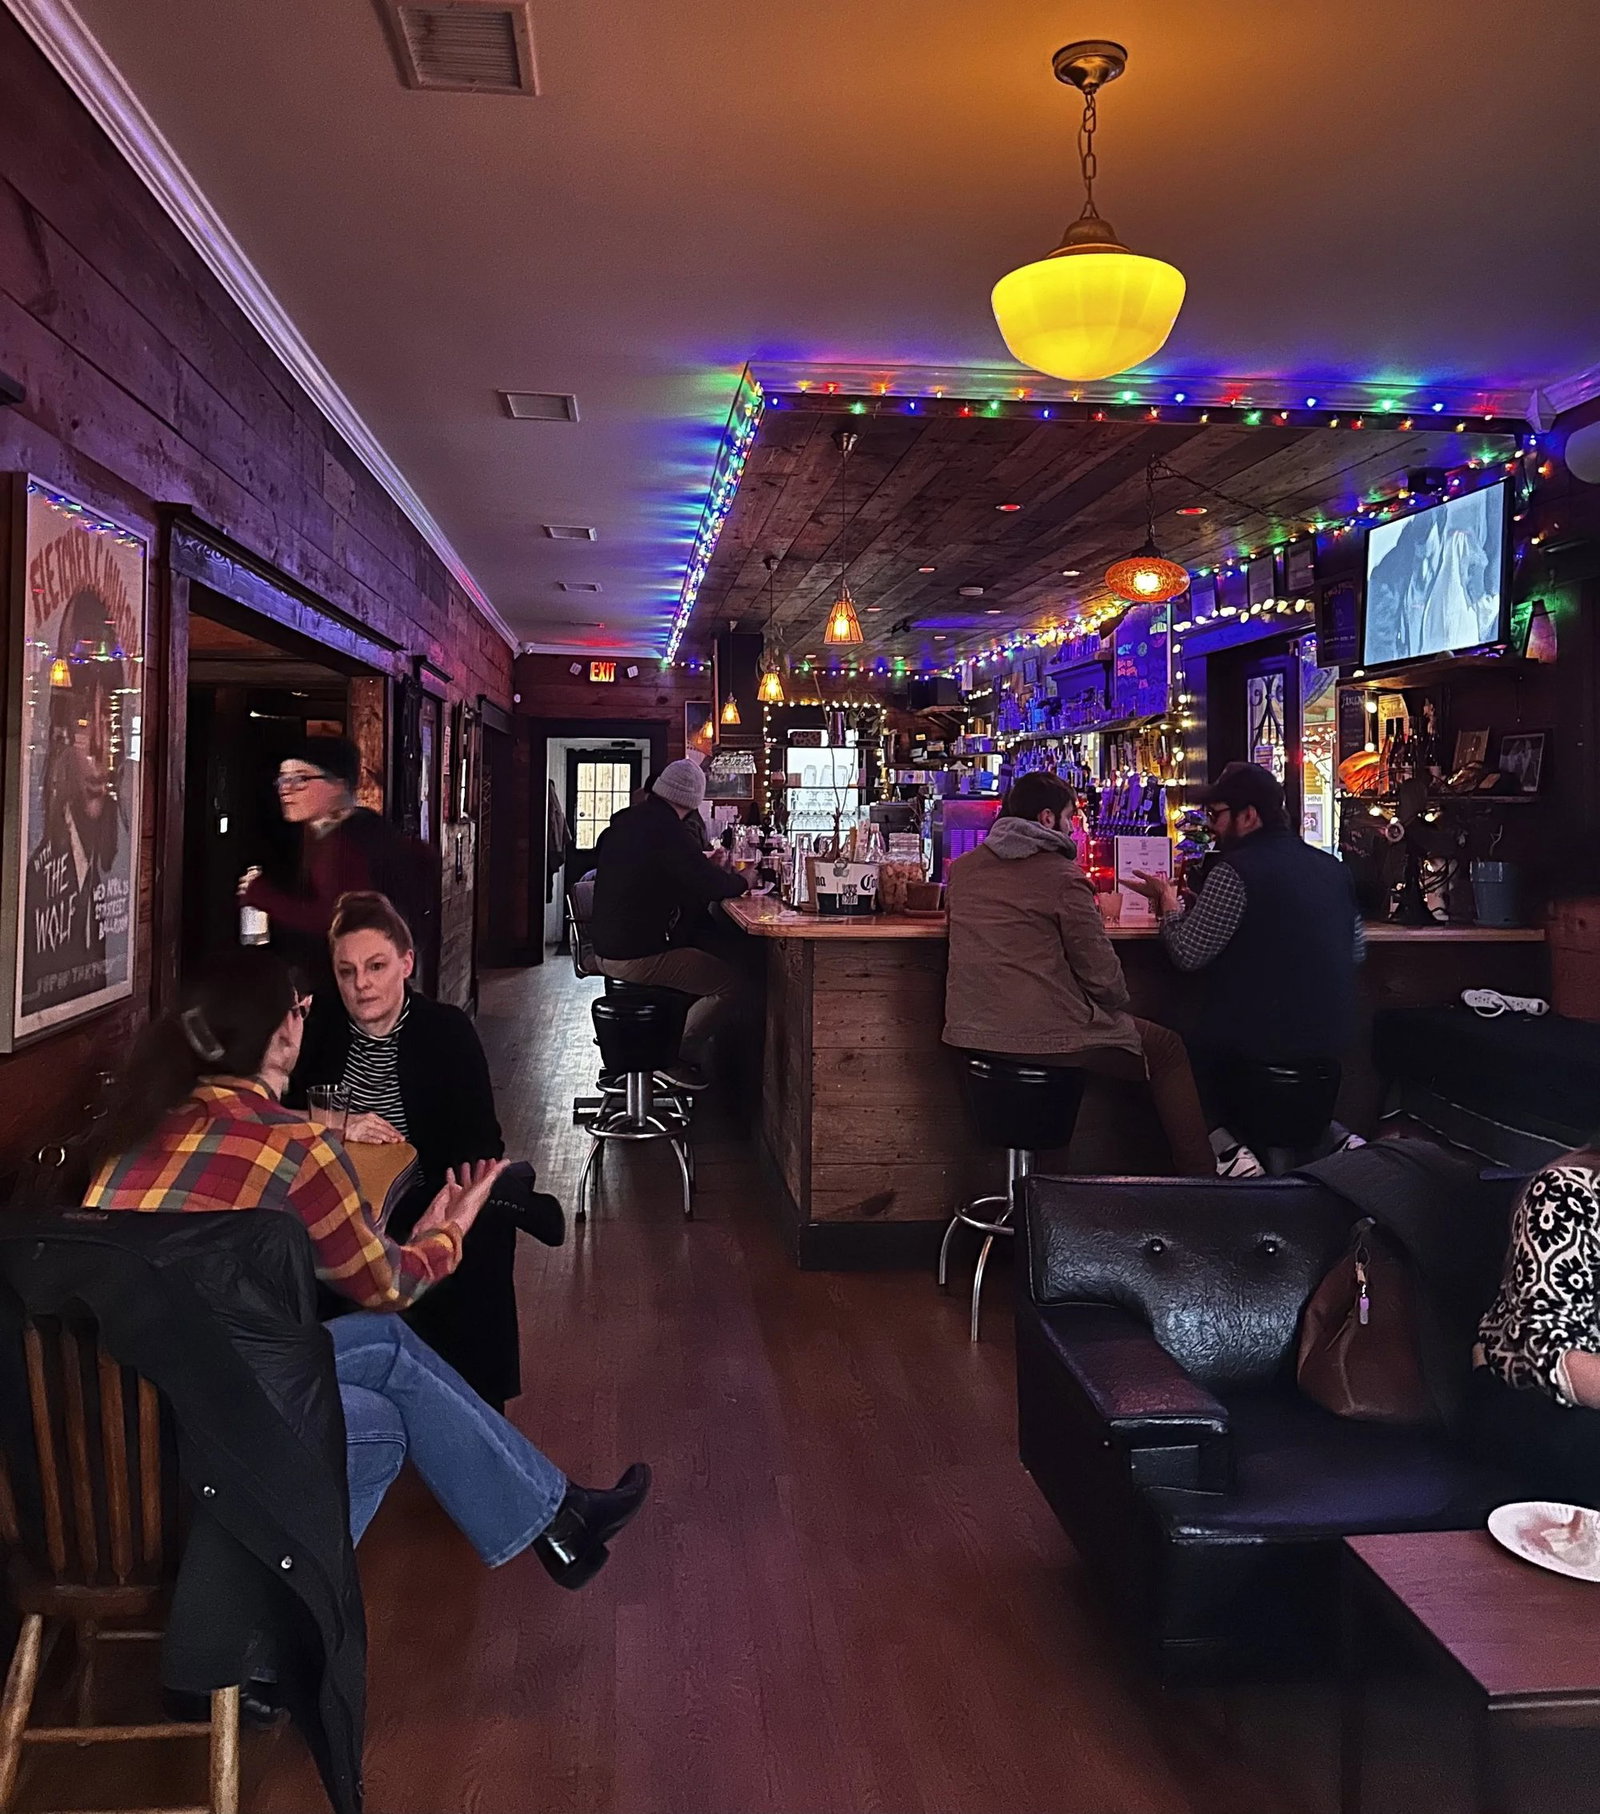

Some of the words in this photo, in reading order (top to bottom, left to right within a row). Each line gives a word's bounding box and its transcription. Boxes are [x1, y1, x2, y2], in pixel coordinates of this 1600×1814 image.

[30, 527, 93, 628] FLETCHER
[589, 661, 616, 682] EXIT
[34, 840, 52, 873] WITH
[43, 852, 69, 900] THE
[92, 883, 105, 902] WED
[35, 891, 77, 954] WOLF
